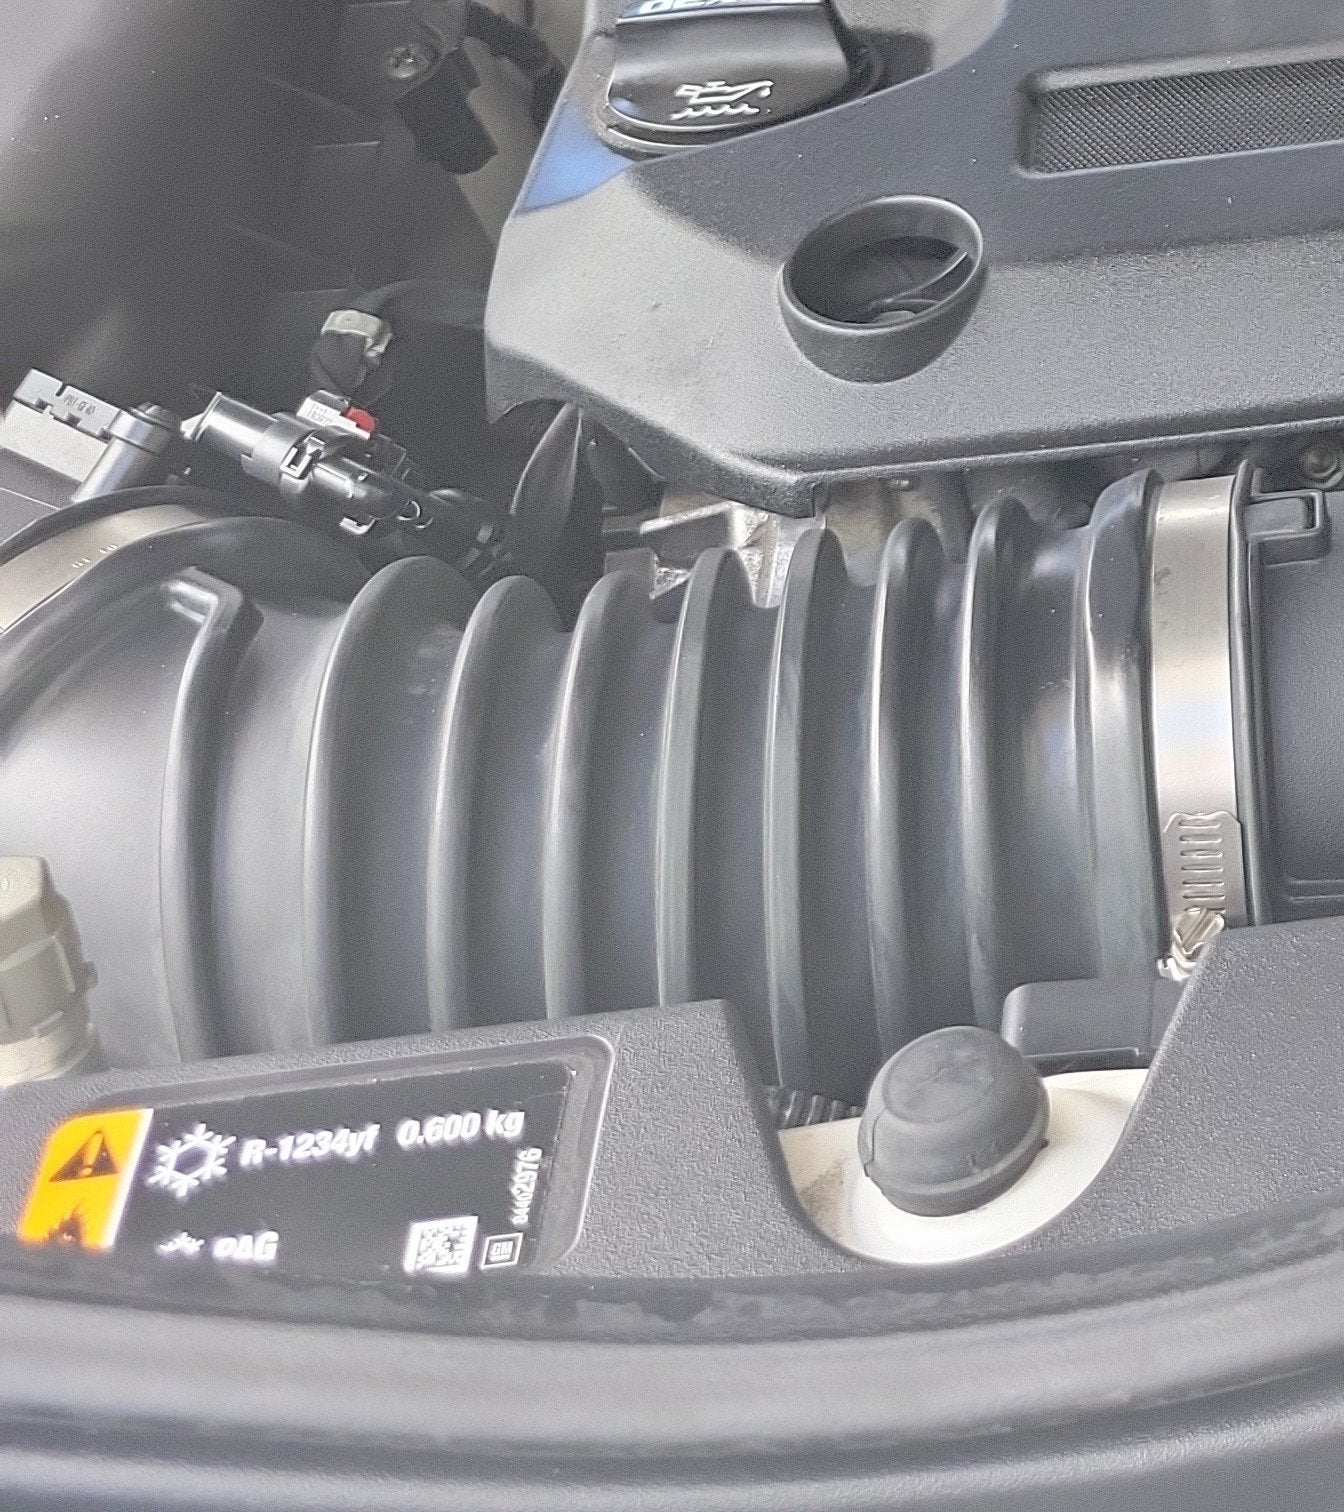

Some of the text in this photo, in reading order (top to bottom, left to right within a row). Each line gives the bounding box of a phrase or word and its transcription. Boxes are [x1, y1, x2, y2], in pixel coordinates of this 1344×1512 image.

[239, 1109, 525, 1167] R-1234yf 0.600 kg
